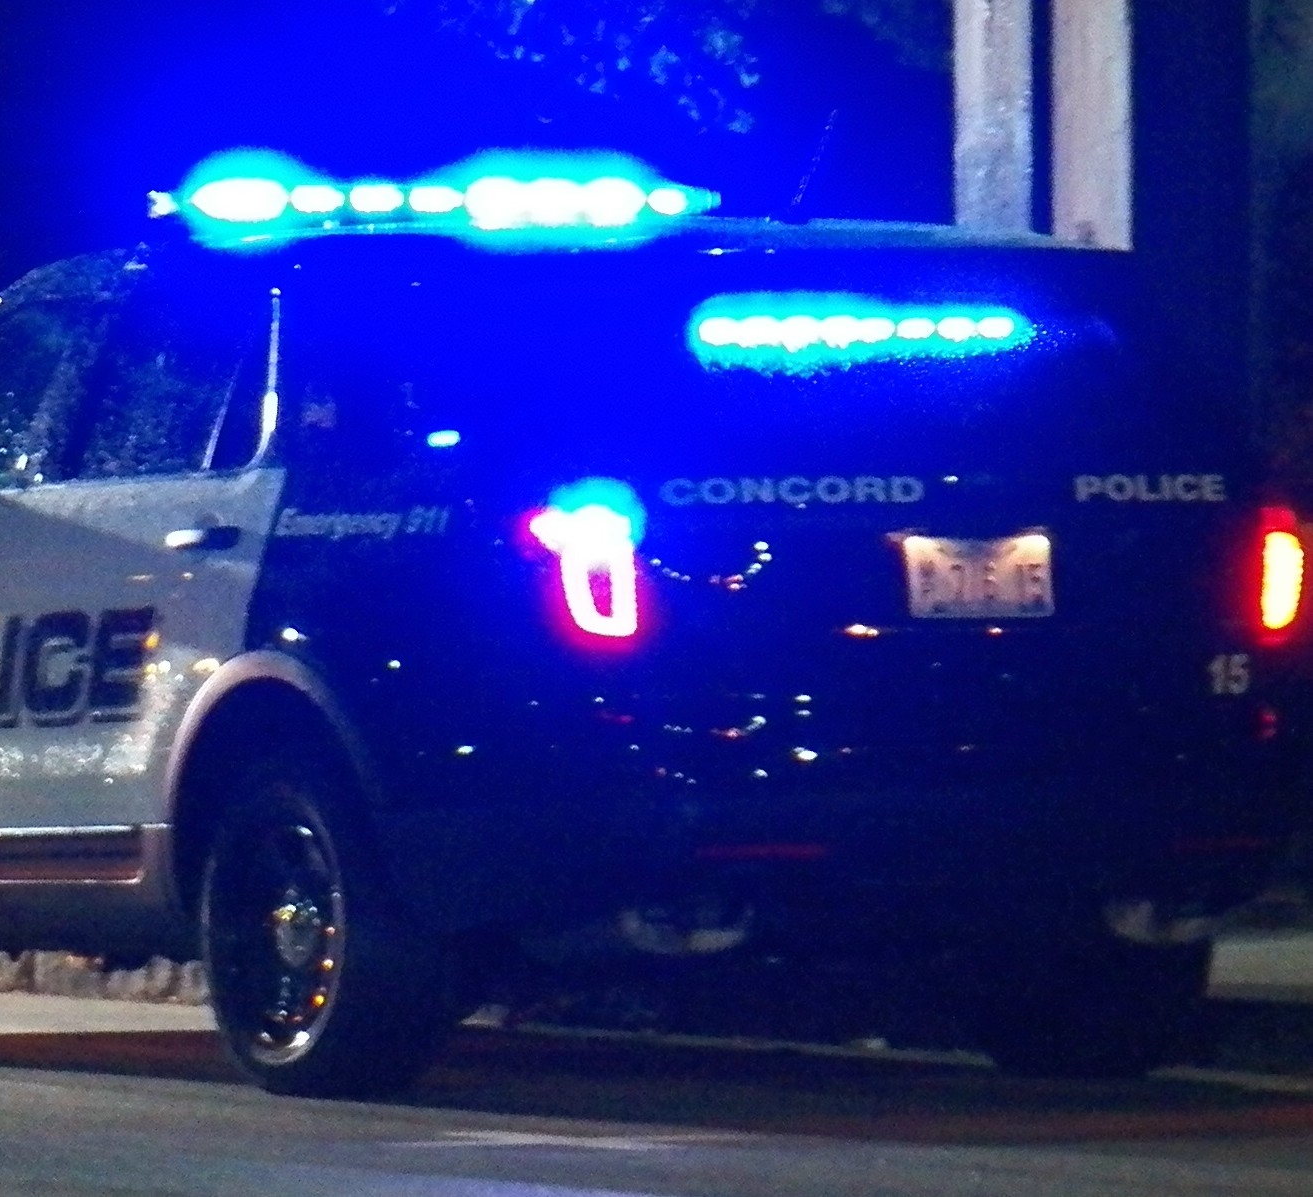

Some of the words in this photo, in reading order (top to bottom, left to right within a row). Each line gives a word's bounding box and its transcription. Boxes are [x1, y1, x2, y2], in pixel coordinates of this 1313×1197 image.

[659, 475, 924, 504] CONCORD
[1075, 474, 1225, 502] POLICE
[274, 507, 402, 541] Emergency
[404, 504, 453, 536] 911
[1208, 653, 1250, 694] 15
